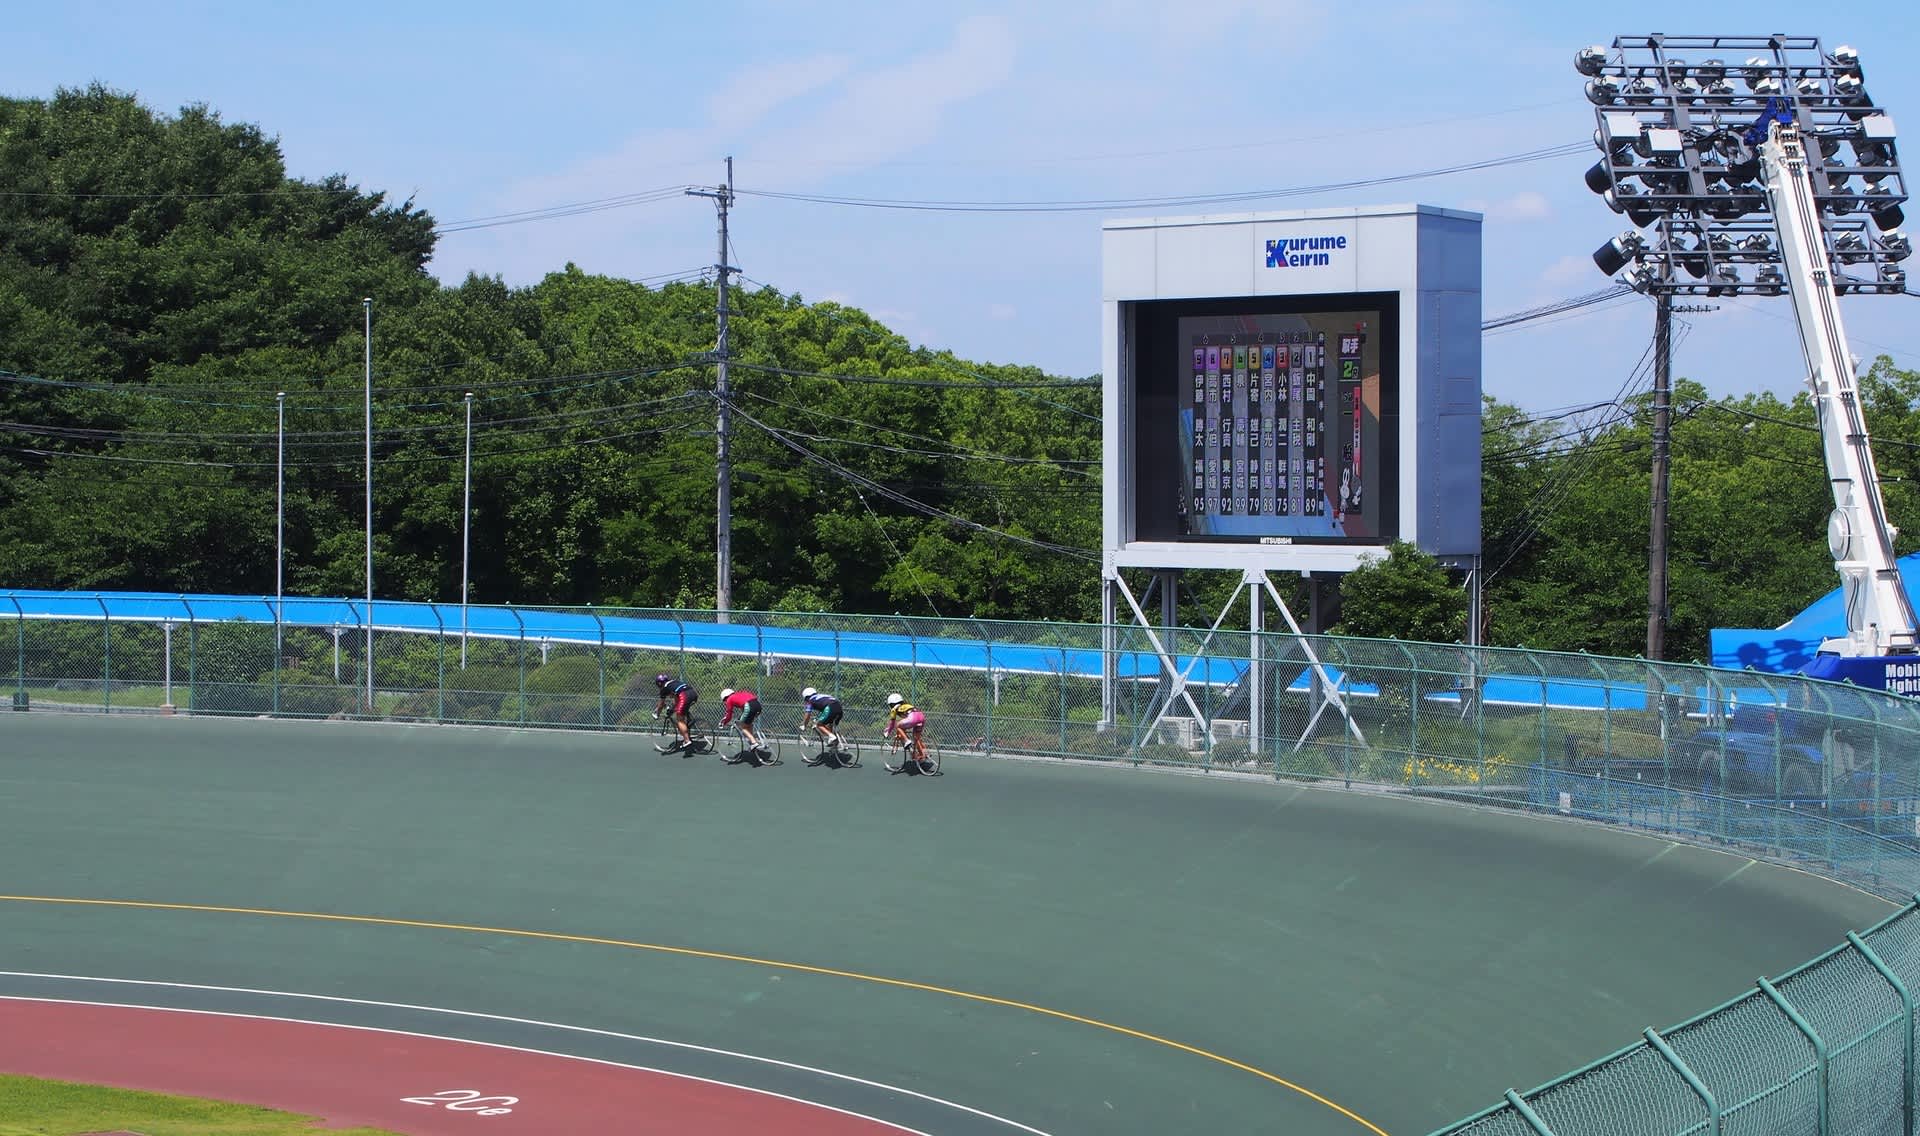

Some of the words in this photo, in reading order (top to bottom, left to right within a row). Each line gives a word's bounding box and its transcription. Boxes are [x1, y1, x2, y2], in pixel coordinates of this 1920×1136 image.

[1266, 236, 1346, 267] Kurume
[1223, 374, 1231, 402] 西村
[1278, 372, 1287, 401] 小林
[1222, 460, 1231, 489] 東京
[1306, 460, 1315, 489] 福岡
[1195, 498, 1204, 511] 95
[1208, 498, 1217, 512] 97
[1222, 498, 1231, 511] 92
[1249, 498, 1260, 512] 79
[1263, 498, 1273, 512] 88
[1277, 498, 1287, 512] 75
[1291, 498, 1301, 512] 81
[1305, 498, 1315, 512] 89
